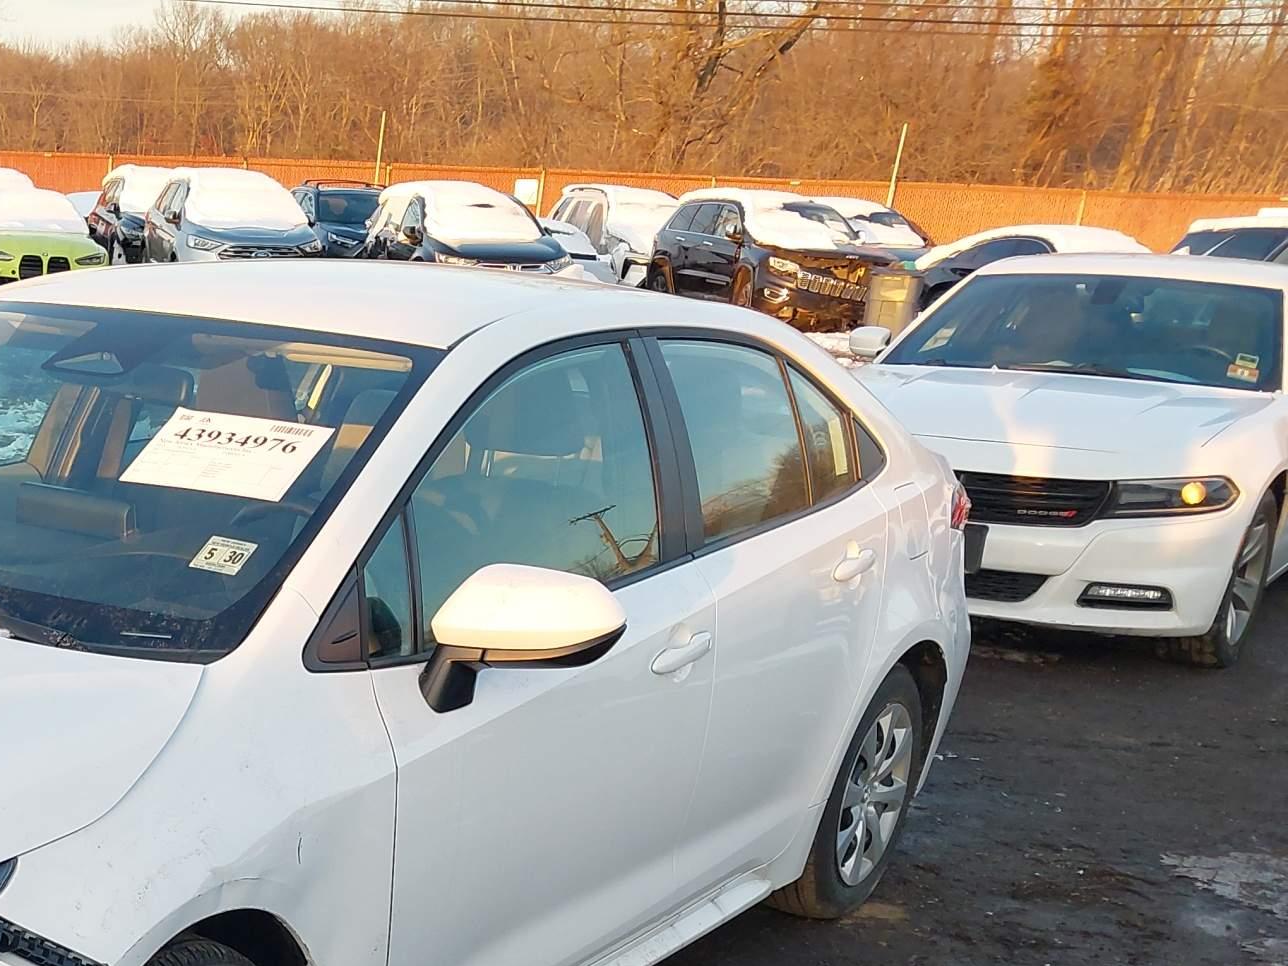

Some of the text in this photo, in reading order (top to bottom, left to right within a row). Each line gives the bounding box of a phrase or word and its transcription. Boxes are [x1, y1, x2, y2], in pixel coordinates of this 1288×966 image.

[174, 427, 302, 454] 43934976
[204, 548, 218, 560] 5
[223, 550, 245, 565] 30
